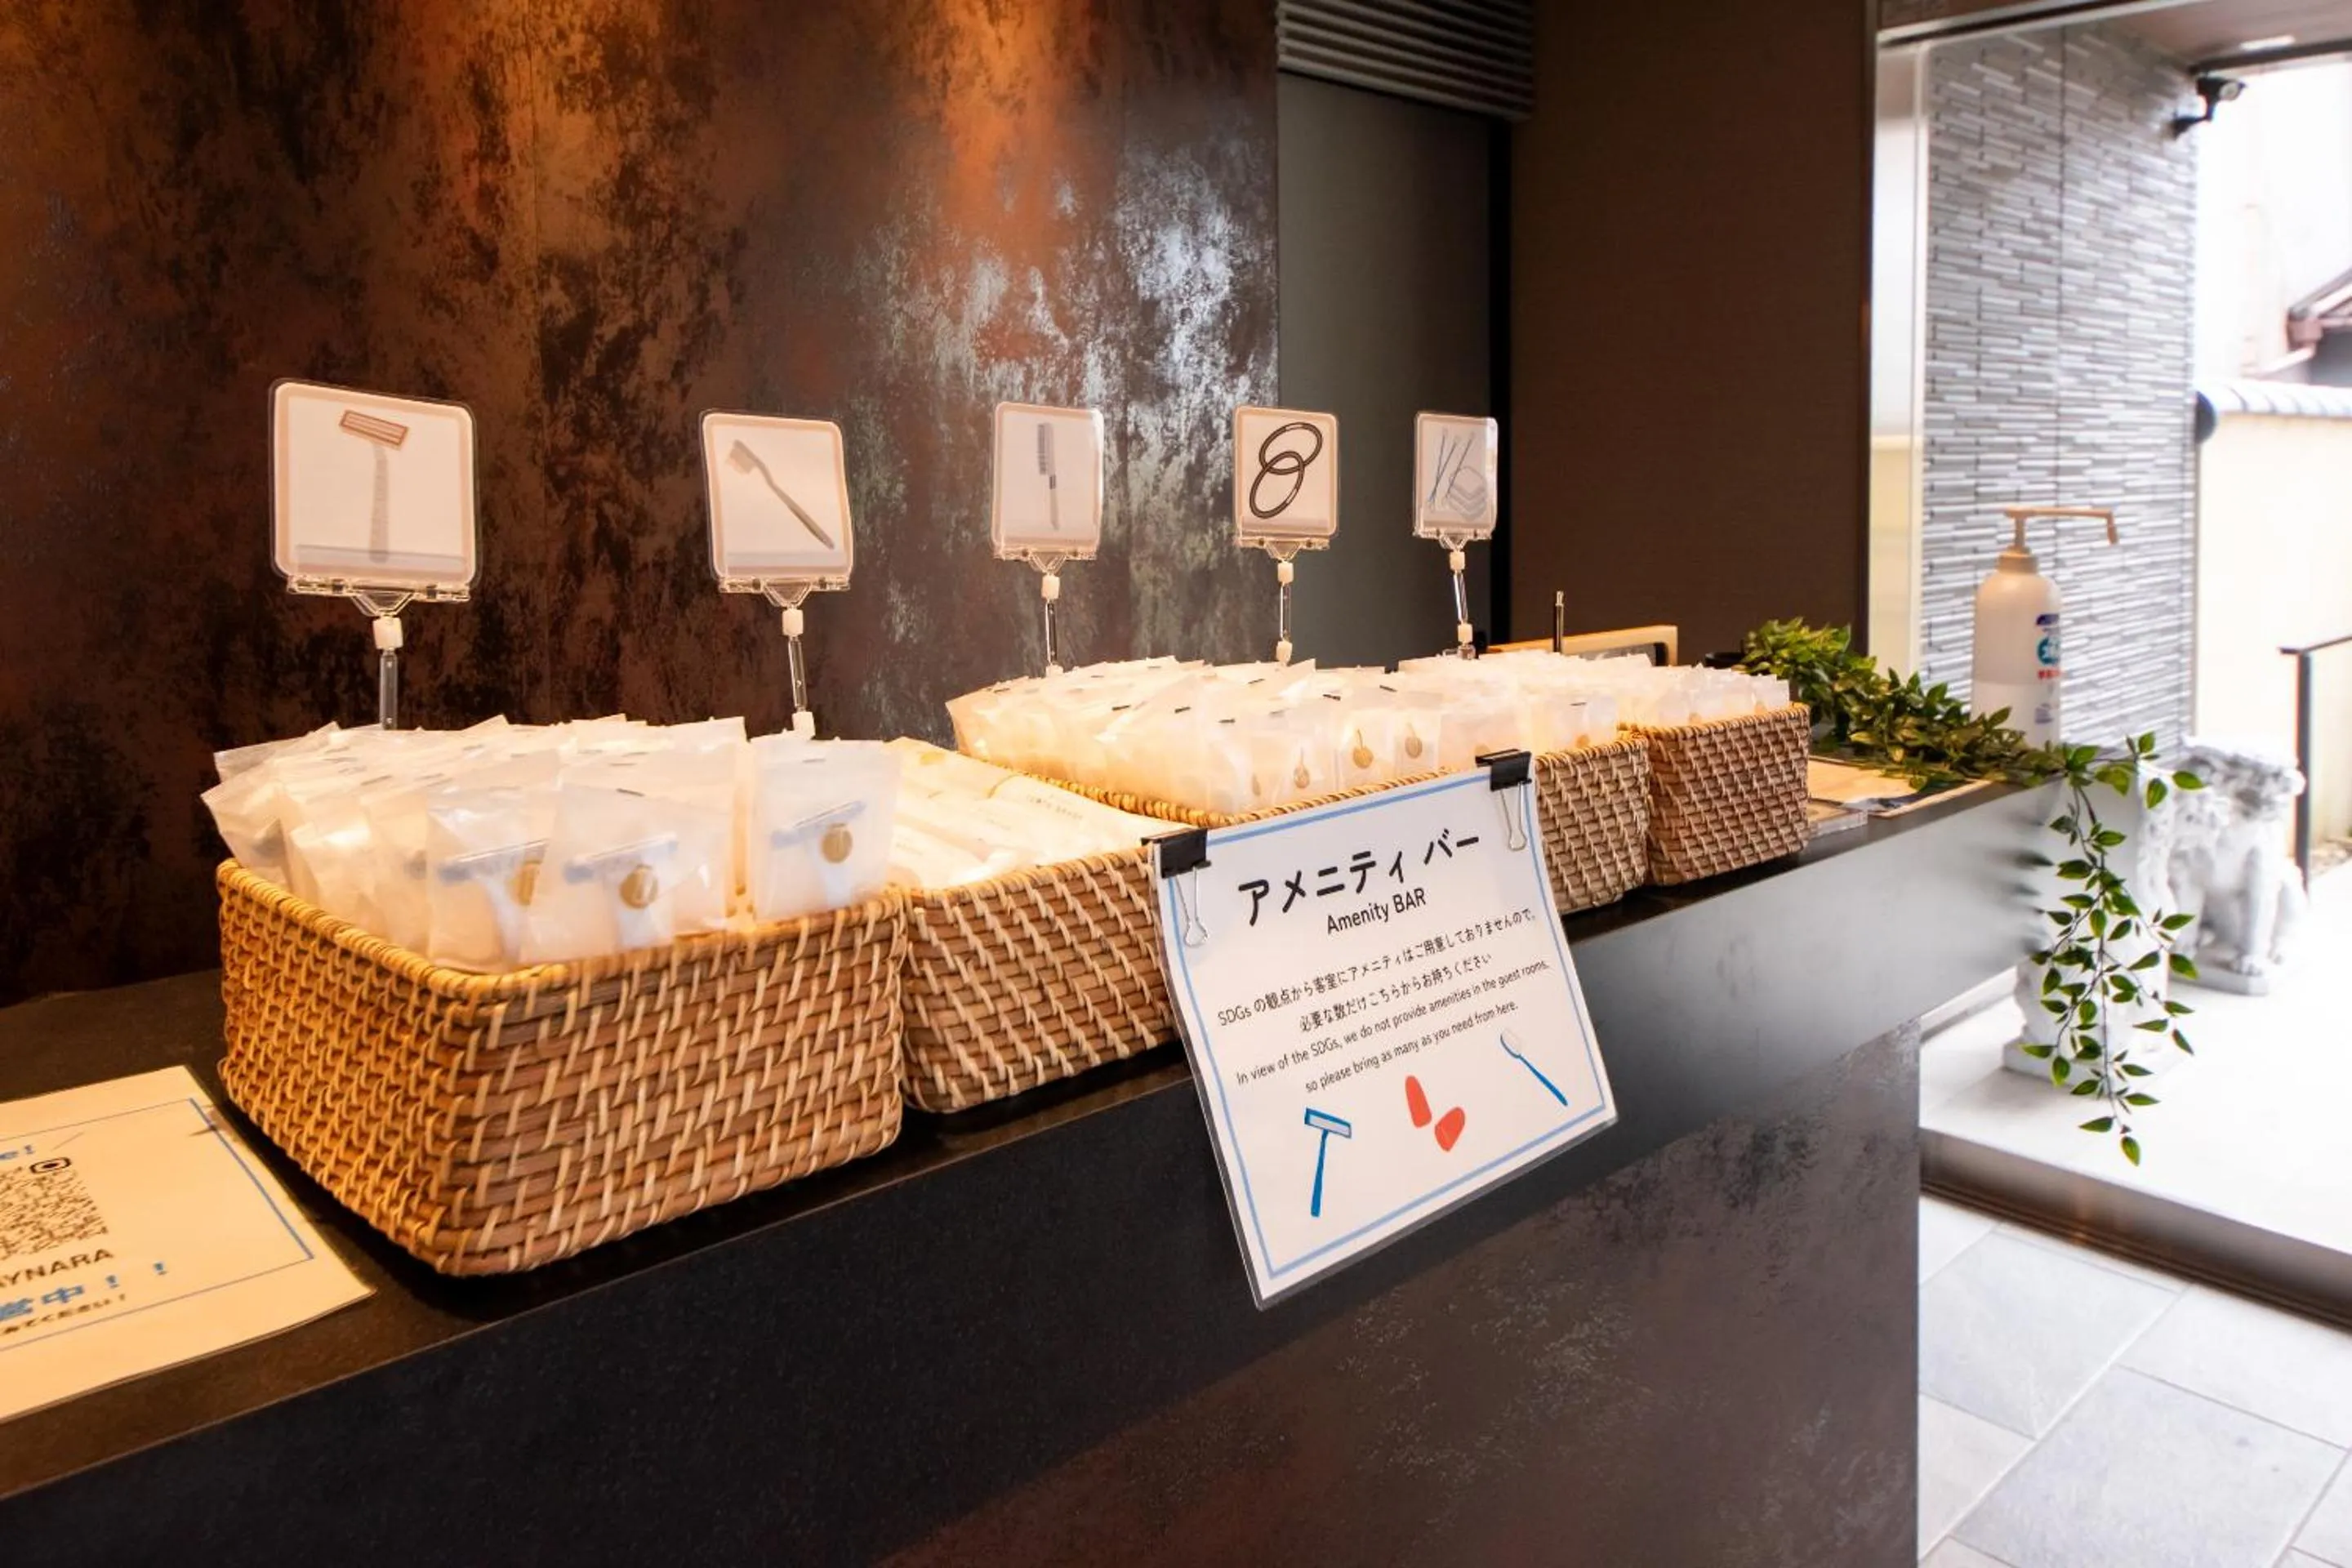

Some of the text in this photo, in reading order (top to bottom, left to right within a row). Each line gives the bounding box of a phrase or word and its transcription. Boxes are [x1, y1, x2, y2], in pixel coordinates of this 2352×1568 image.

[1327, 887, 1427, 934] Amenity BAR
[1236, 1071, 1249, 1086] In
[1251, 1062, 1276, 1080] view
[1277, 1053, 1290, 1070] of
[1291, 1049, 1309, 1064] the
[1310, 1037, 1343, 1057] SDGs,
[1343, 1031, 1358, 1045] we
[1360, 1024, 1373, 1039] do
[1374, 1018, 1391, 1033] not
[1392, 1004, 1428, 1029] provide
[1429, 987, 1472, 1013] amenities
[1472, 983, 1481, 996] in
[1482, 978, 1496, 991] the
[1498, 969, 1521, 989] guest
[1305, 1000, 1518, 1093] so please bring as many as you need from here.
